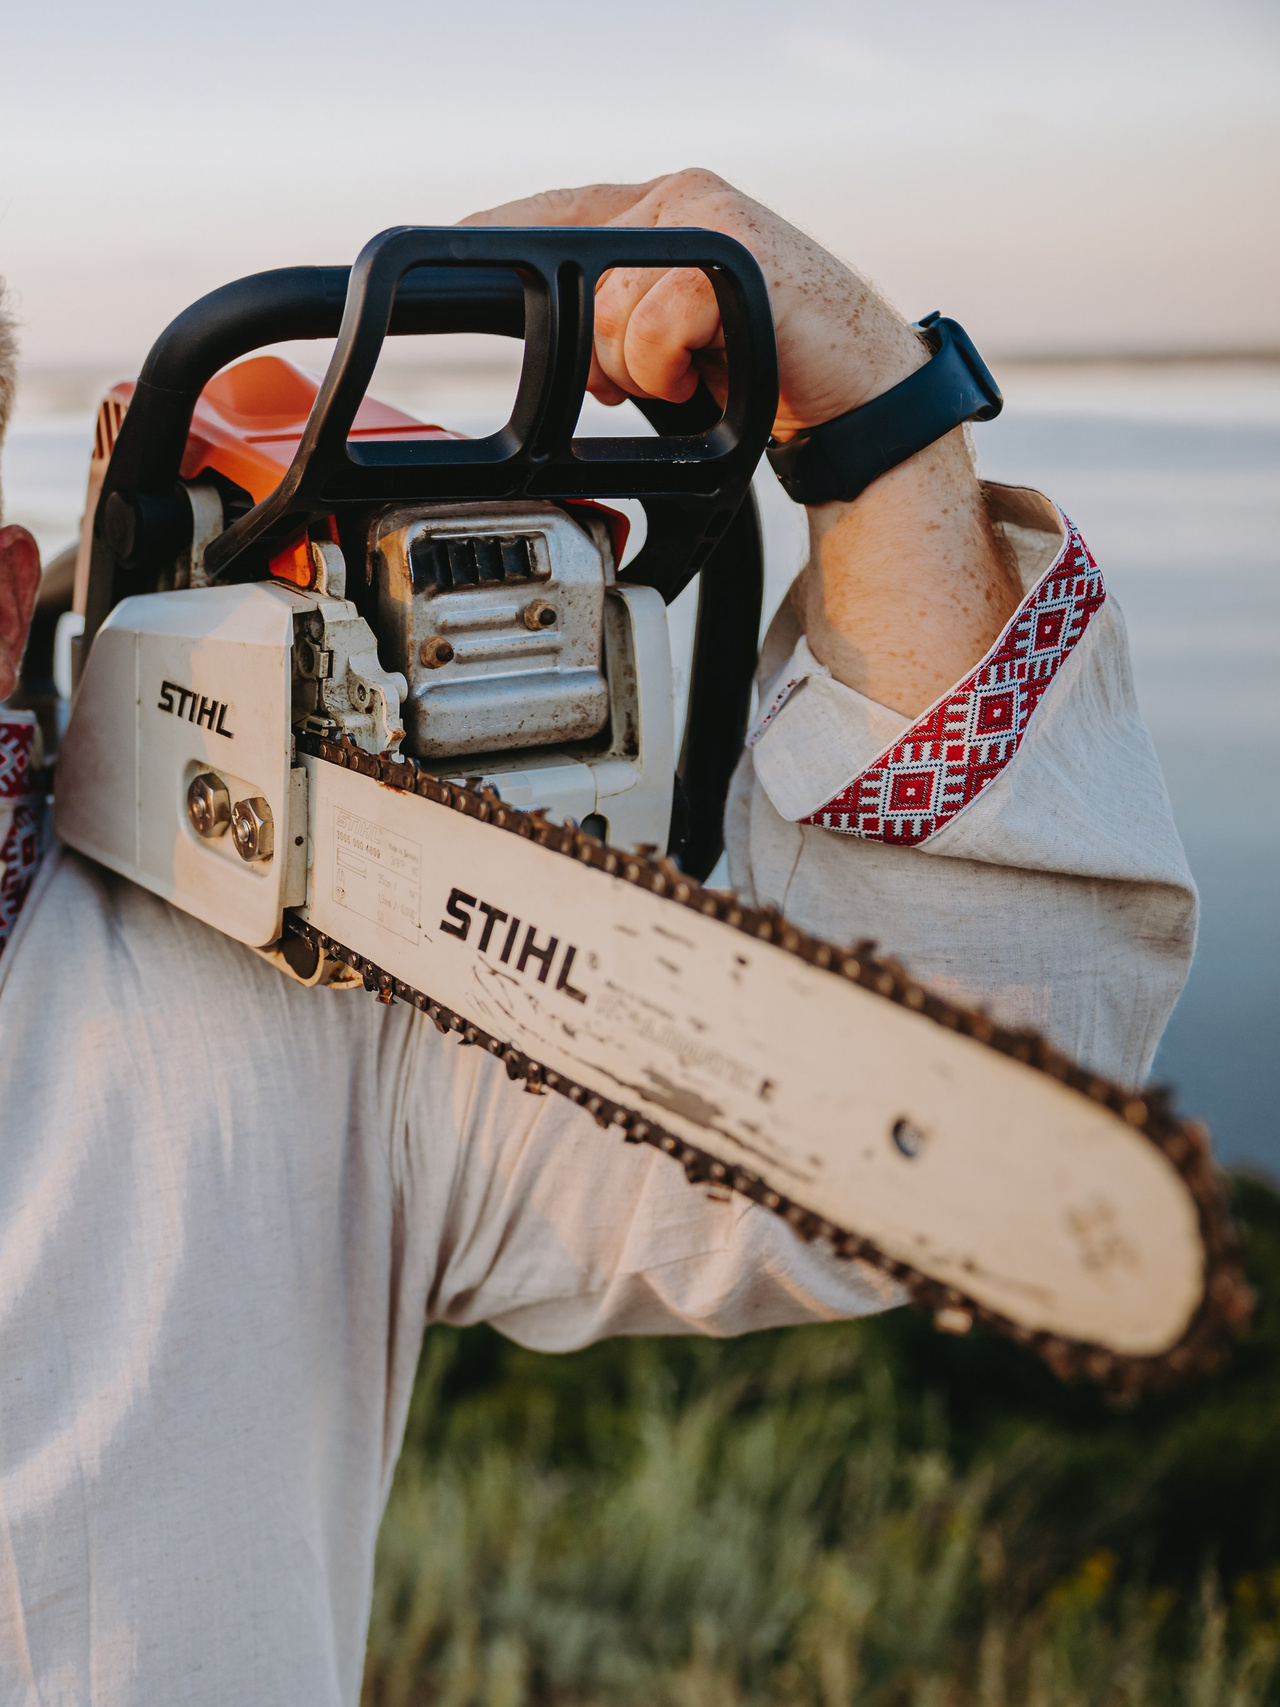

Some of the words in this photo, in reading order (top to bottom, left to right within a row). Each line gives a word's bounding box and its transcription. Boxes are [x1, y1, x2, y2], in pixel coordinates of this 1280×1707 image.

[157, 680, 235, 739] STIHL
[337, 810, 381, 845] STIHL
[439, 887, 588, 1004] STIHL
